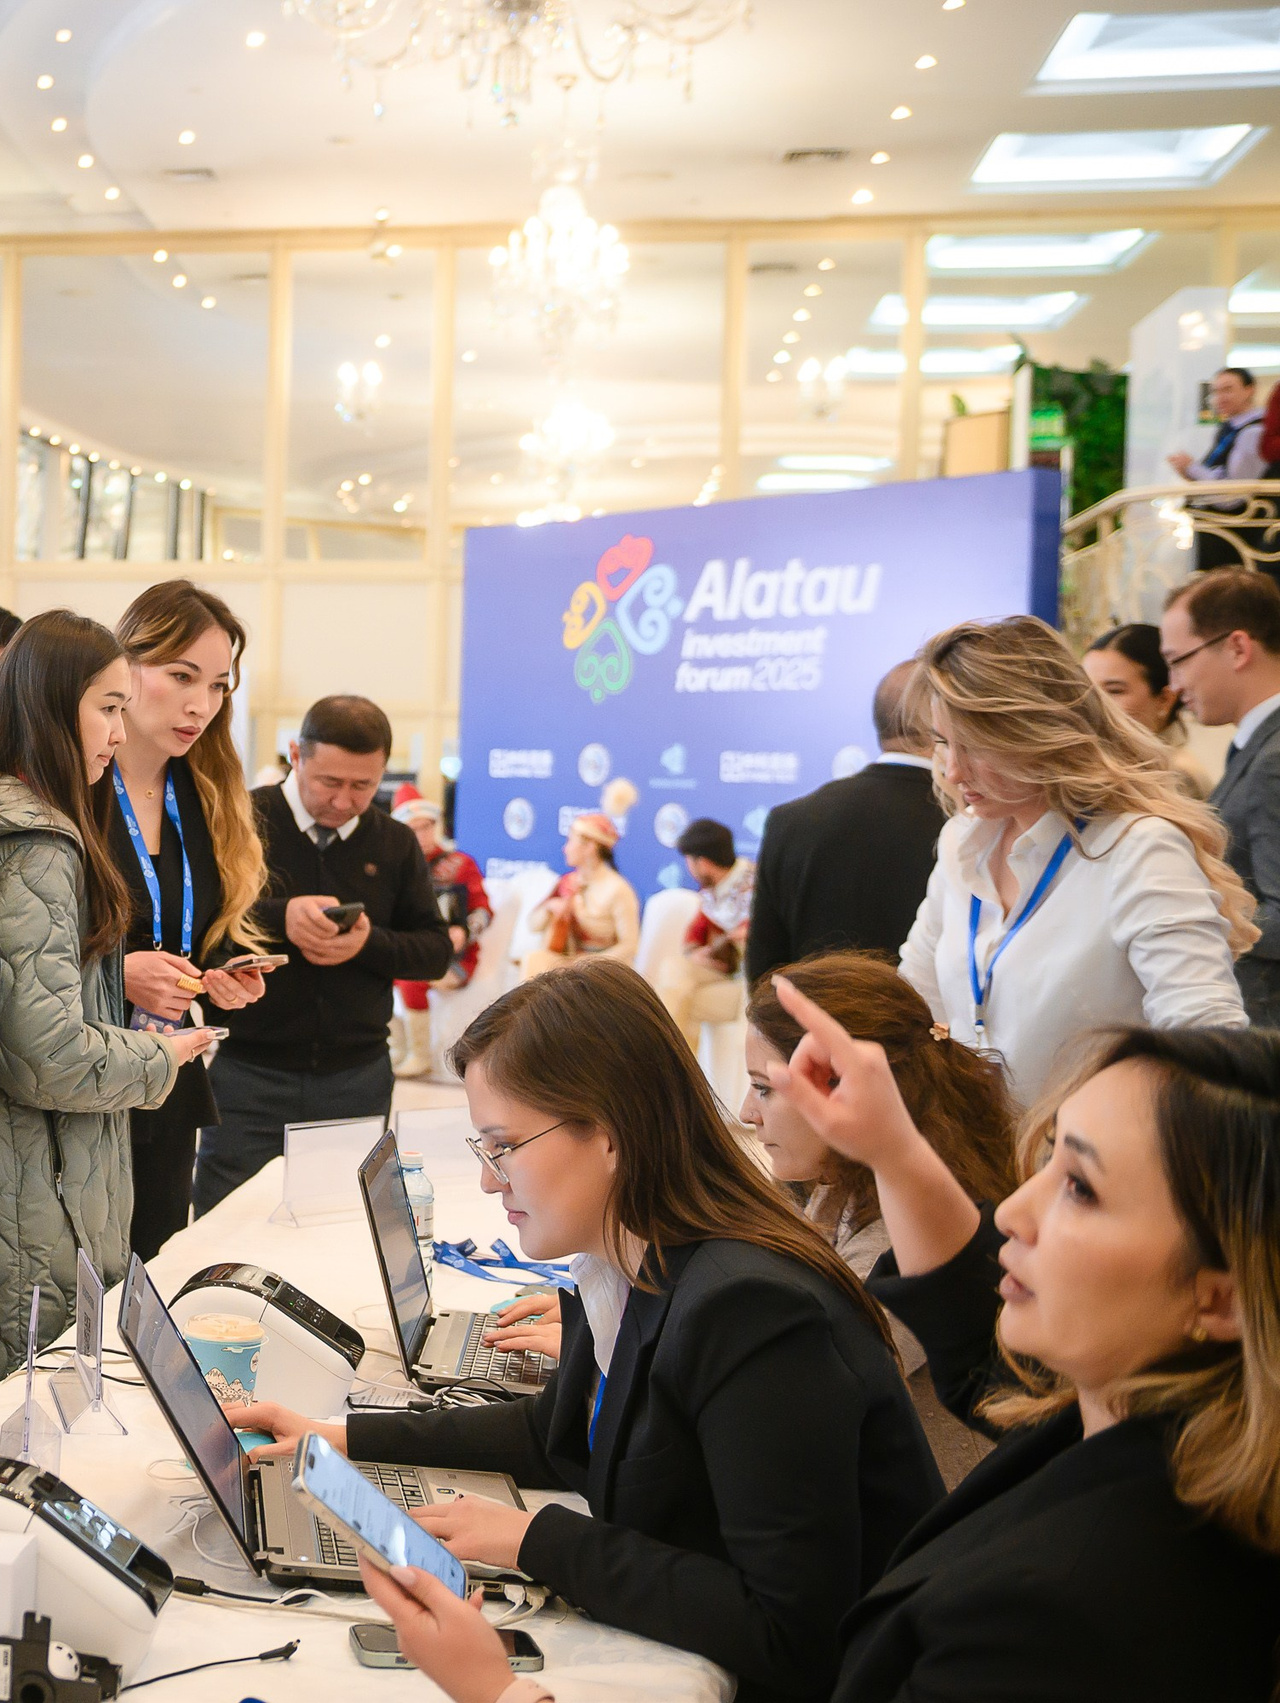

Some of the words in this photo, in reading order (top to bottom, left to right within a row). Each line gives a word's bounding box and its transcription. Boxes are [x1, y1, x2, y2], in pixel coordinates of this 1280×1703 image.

[683, 557, 881, 622] Alatau
[681, 625, 826, 659] investment
[675, 660, 753, 693] forum
[751, 656, 822, 691] 2025
